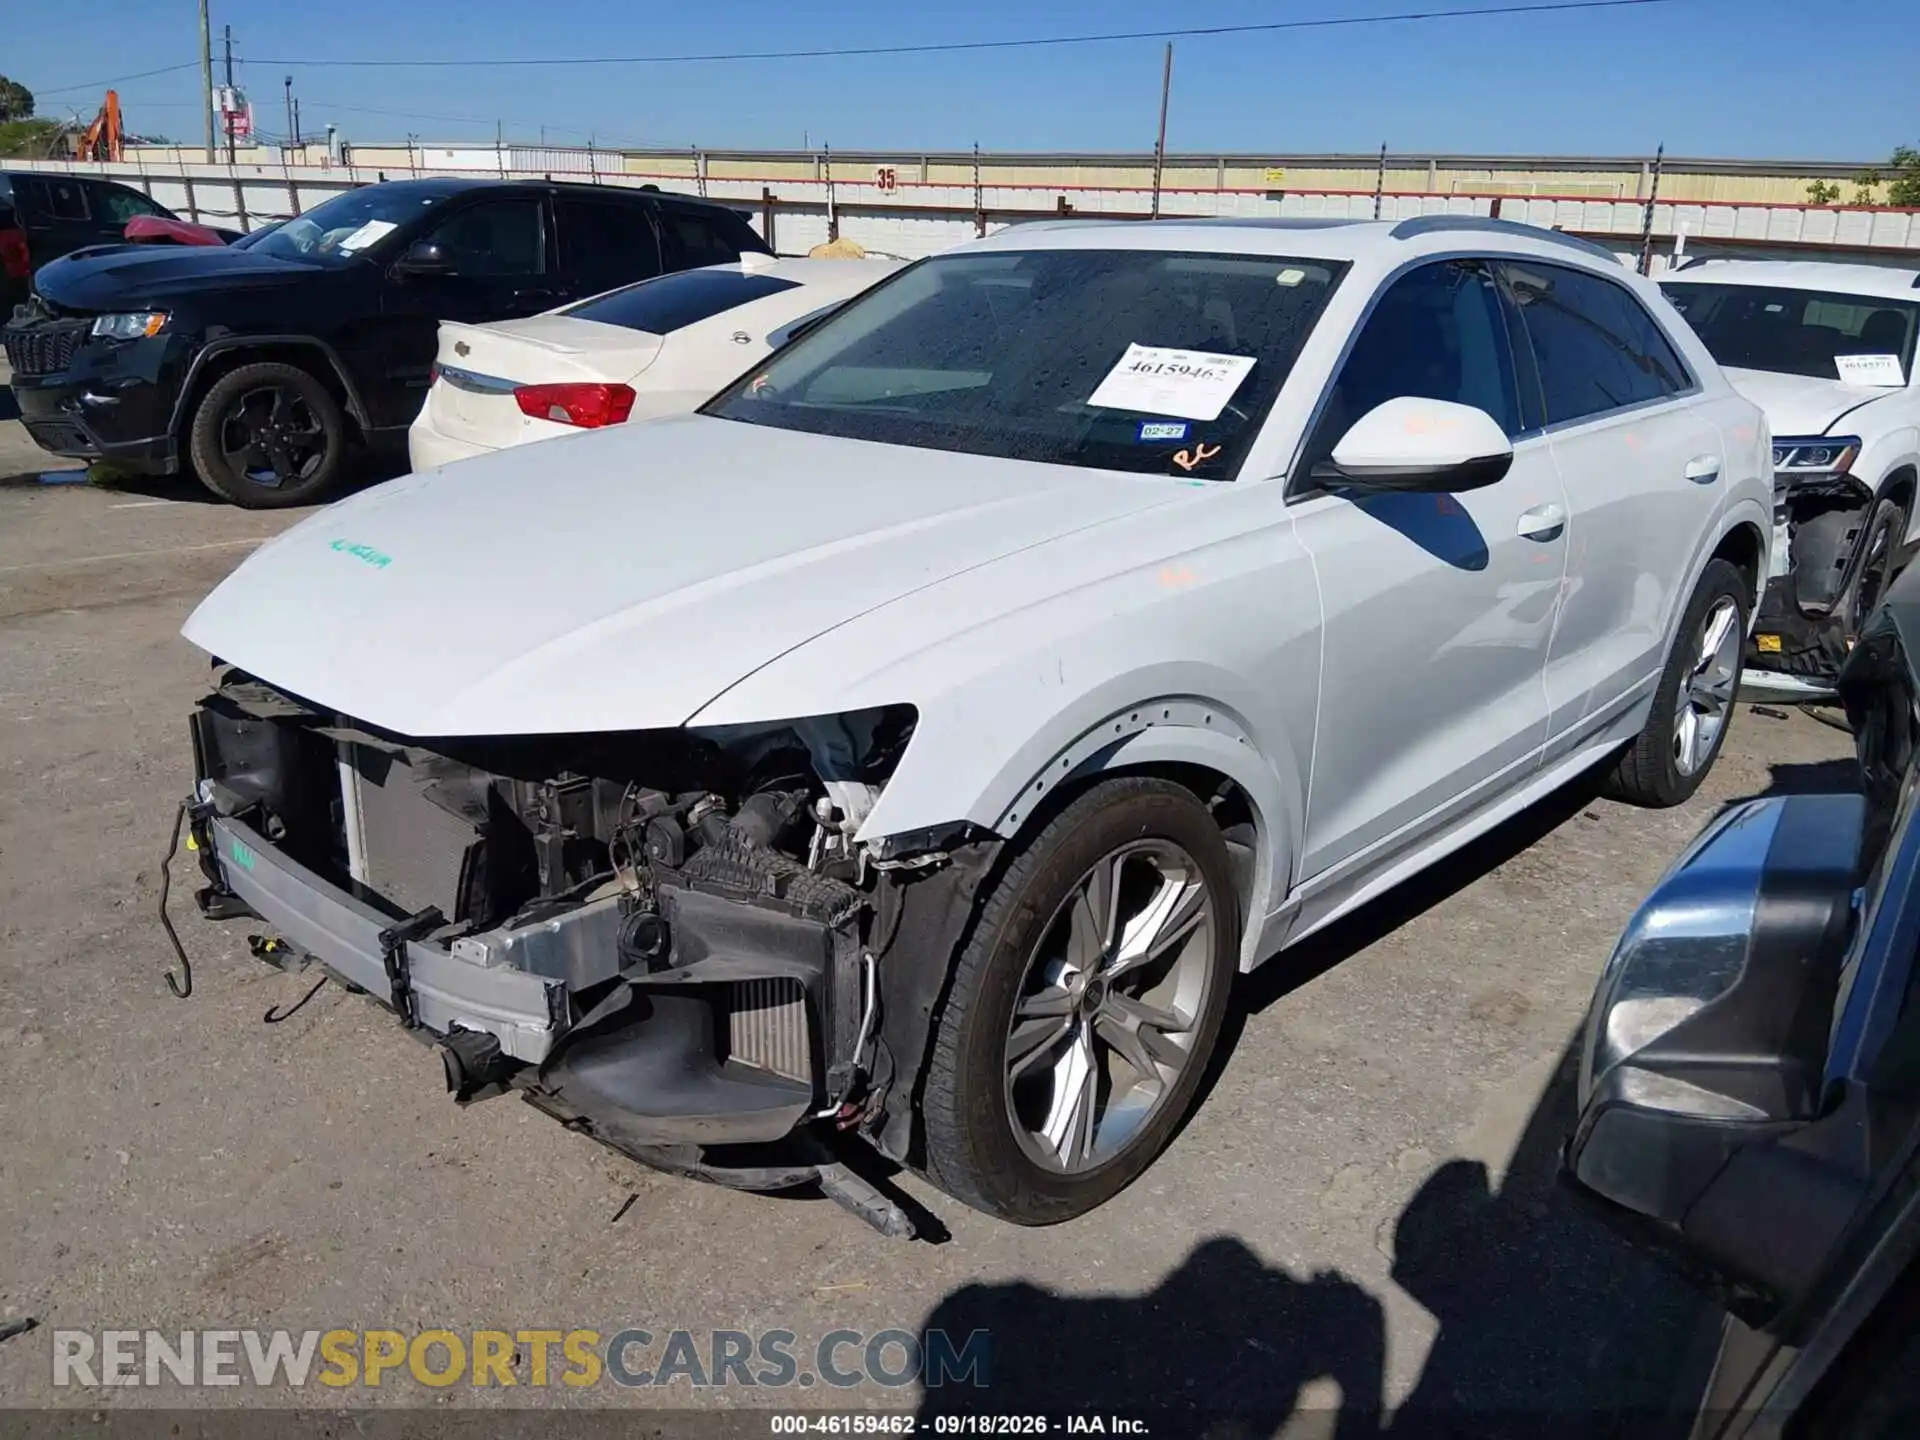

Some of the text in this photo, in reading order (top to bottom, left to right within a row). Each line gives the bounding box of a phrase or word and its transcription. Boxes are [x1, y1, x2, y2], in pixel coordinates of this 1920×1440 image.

[877, 168, 896, 190] 35
[1128, 360, 1229, 382] 46159462
[1143, 426, 1183, 436] 02-27
